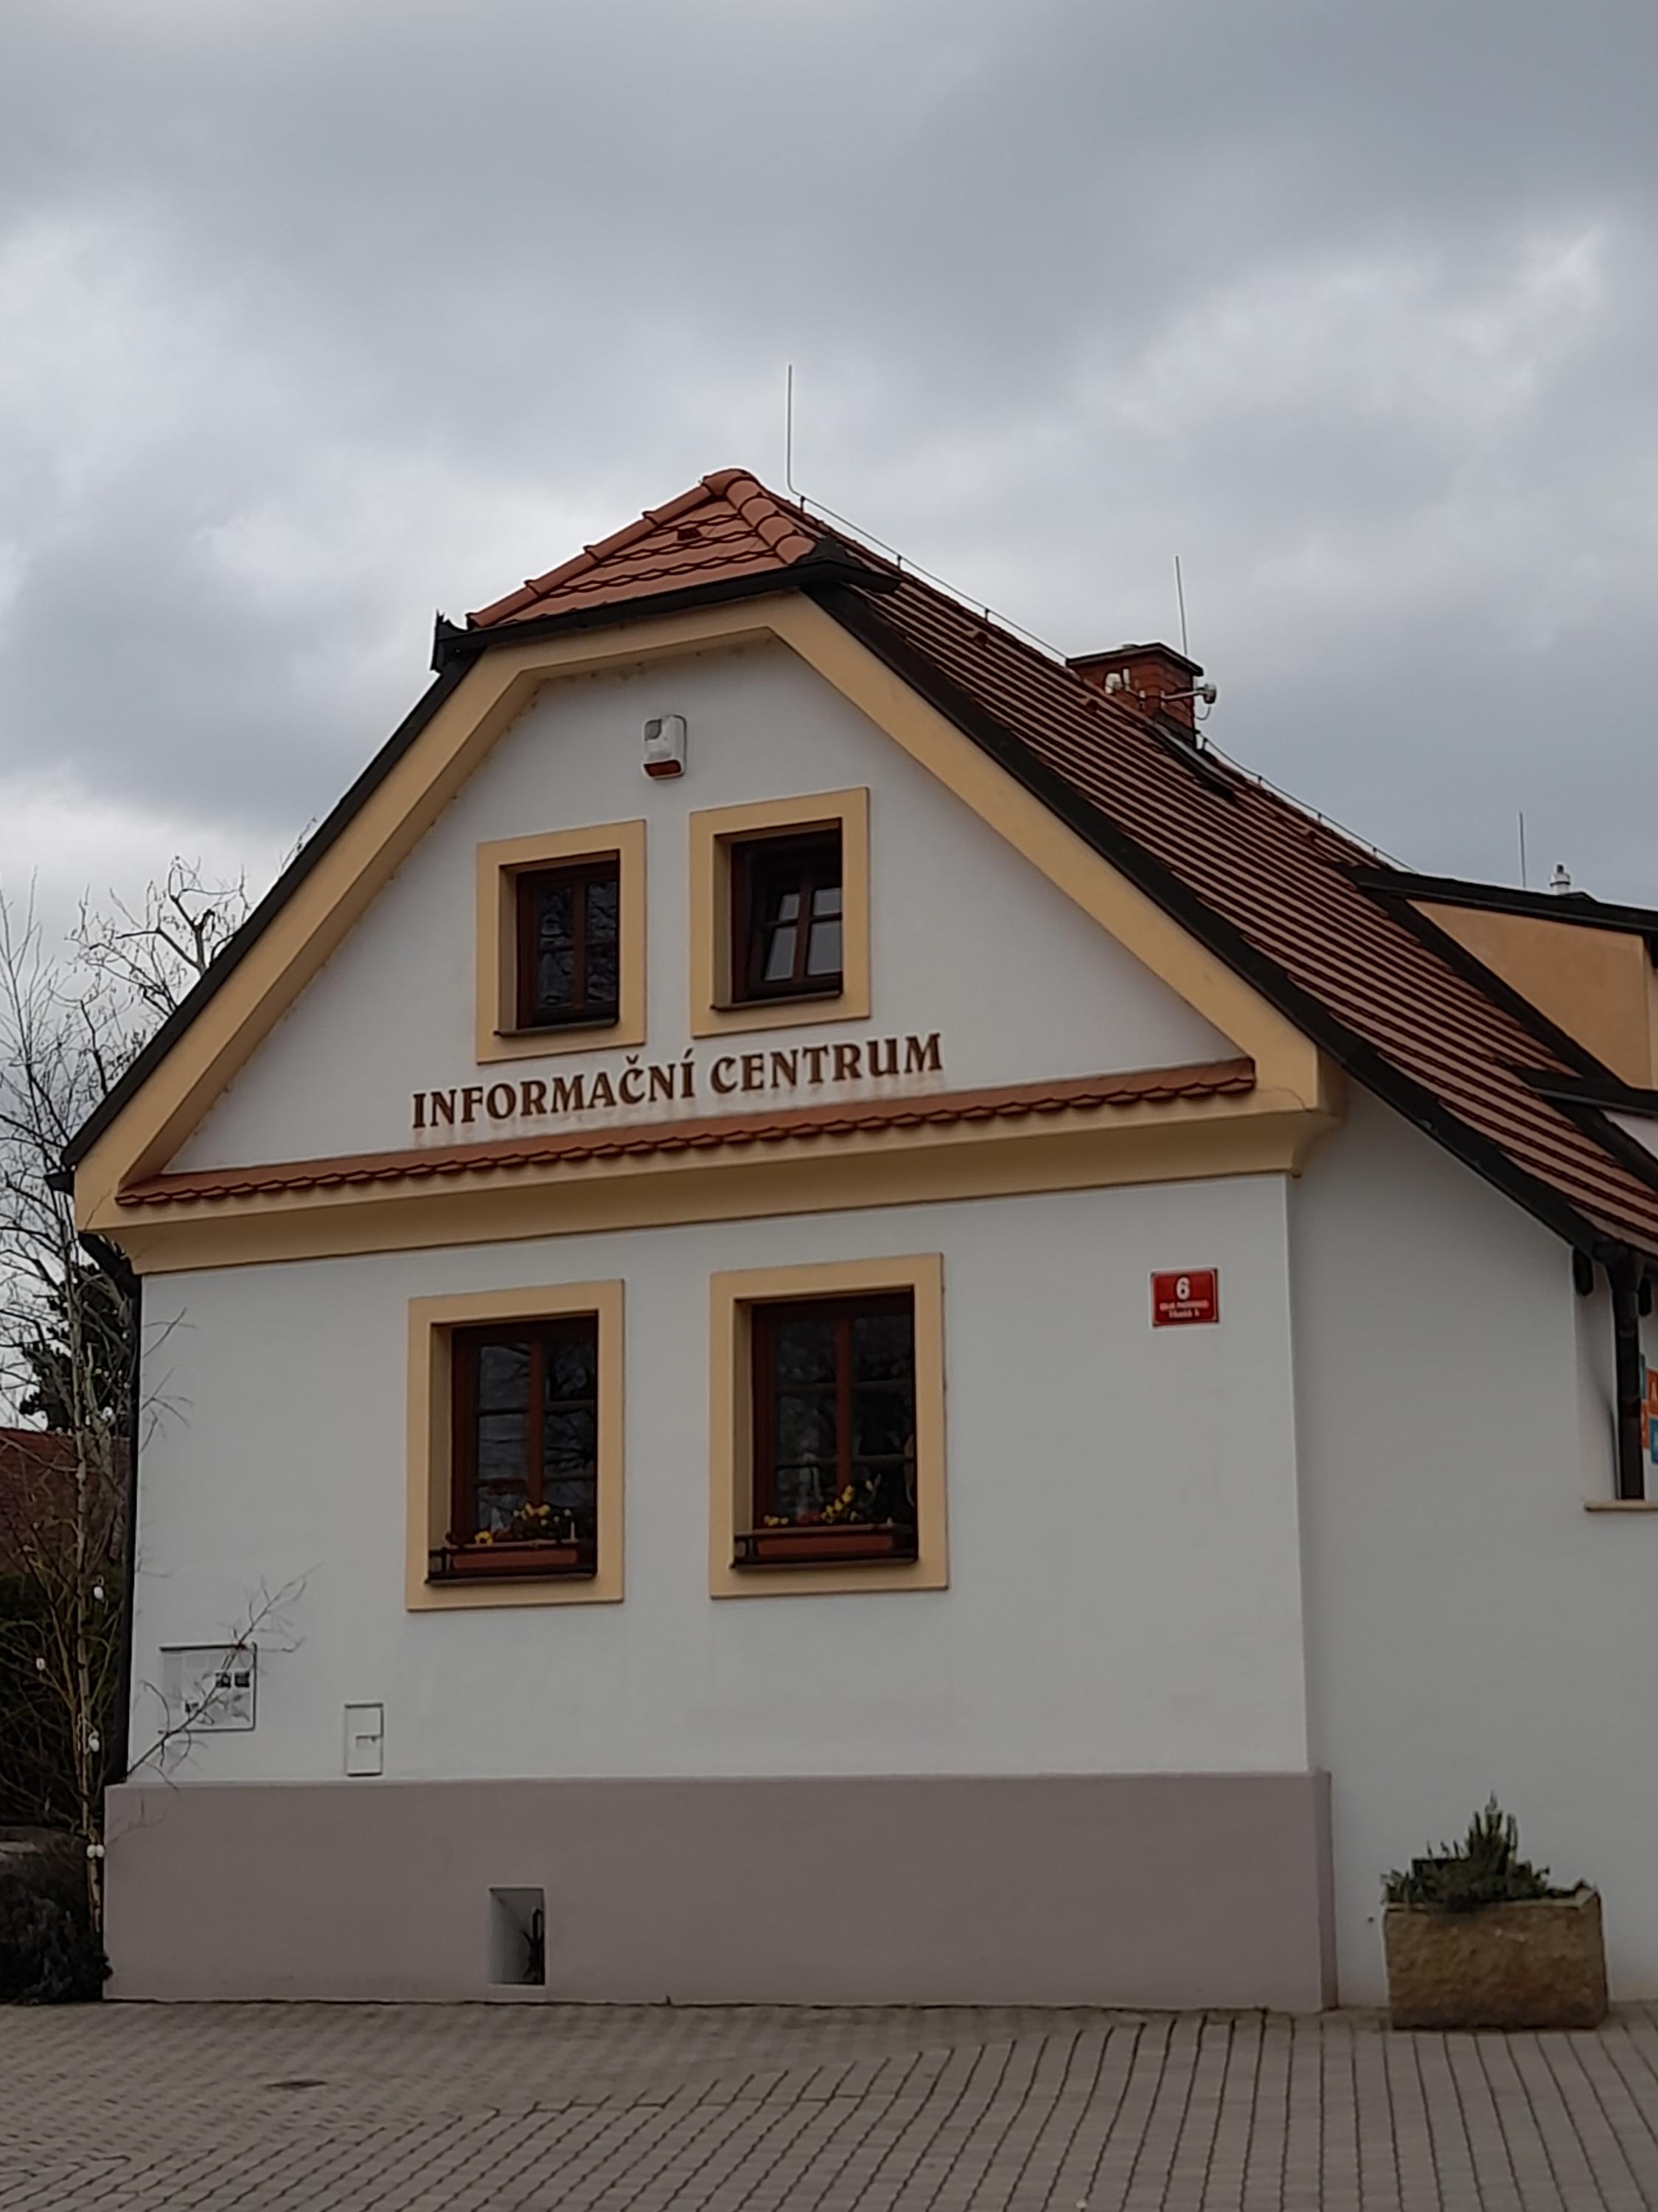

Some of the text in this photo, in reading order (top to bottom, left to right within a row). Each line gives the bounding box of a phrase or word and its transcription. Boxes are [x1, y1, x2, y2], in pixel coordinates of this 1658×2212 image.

[412, 1033, 943, 1129] INFORMAČNÍ CENTRUM
[1176, 1276, 1191, 1300] 6
